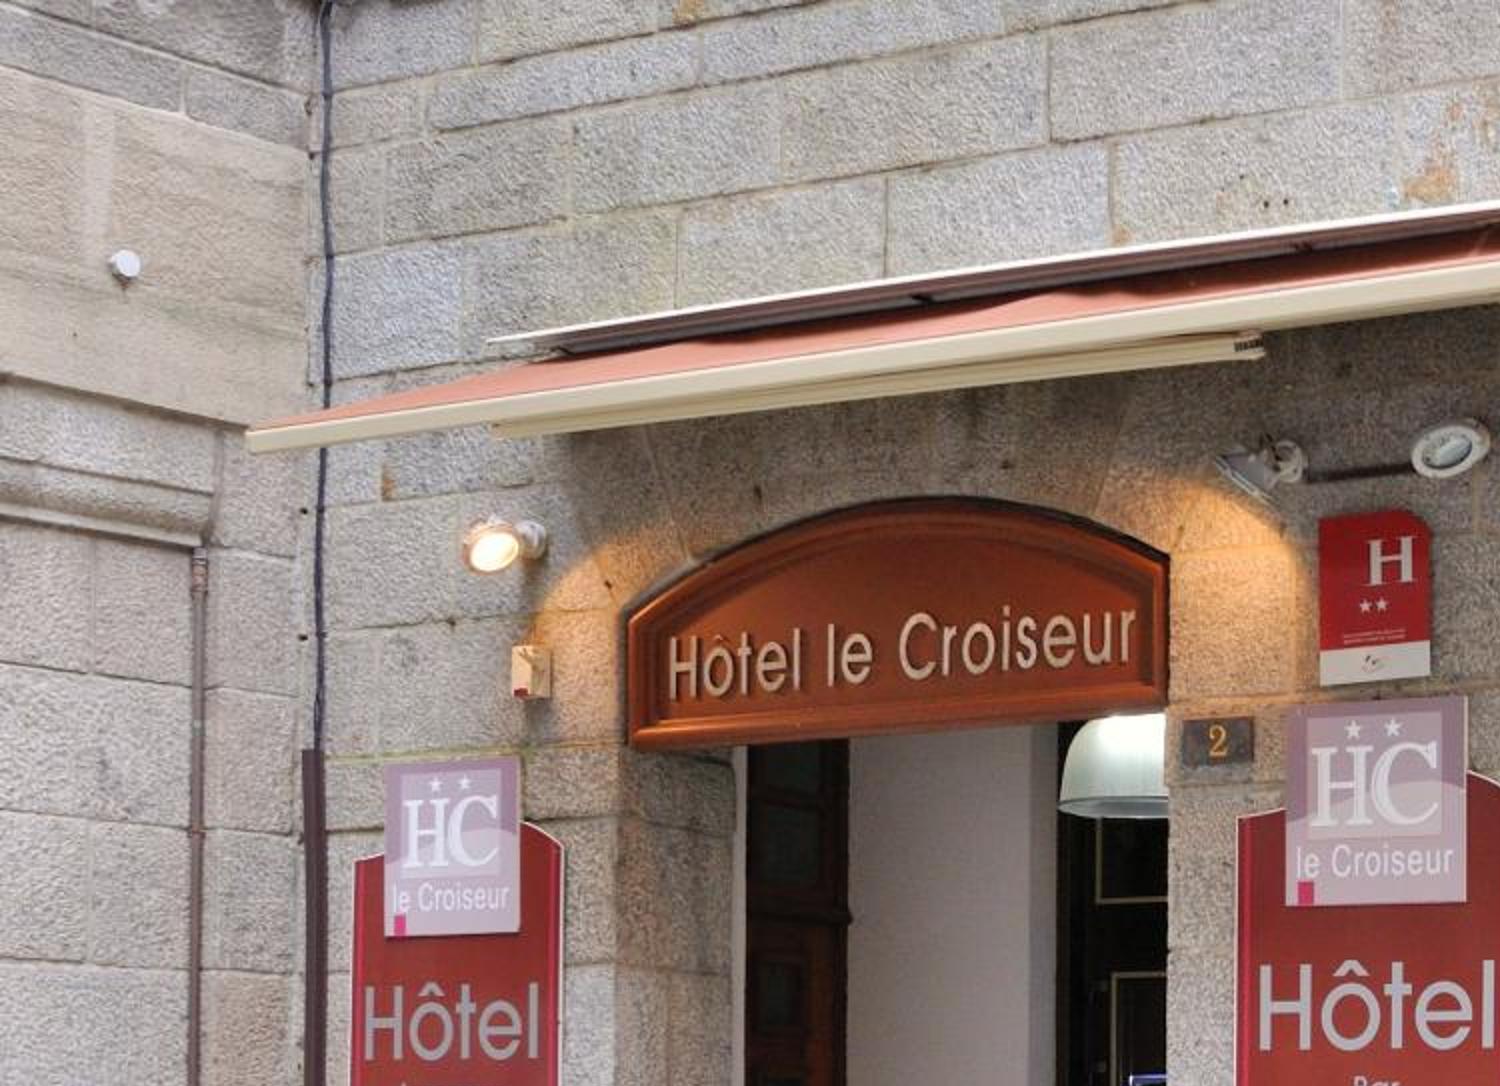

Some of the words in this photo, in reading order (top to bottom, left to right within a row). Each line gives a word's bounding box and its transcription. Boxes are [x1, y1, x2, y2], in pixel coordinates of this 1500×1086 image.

[1366, 535, 1416, 586] H
[668, 627, 801, 702] Hôtel
[827, 622, 874, 687] le
[899, 604, 1137, 681] Croiseur
[1207, 725, 1229, 758] 2
[1310, 740, 1441, 828] HC
[400, 794, 499, 871] HC
[1297, 846, 1321, 878] le
[1331, 843, 1454, 878] Croiseur
[393, 883, 410, 914] le
[417, 882, 510, 912] Croiseur
[363, 981, 541, 1062] Hôtel
[1258, 959, 1496, 1053] Hôtel
